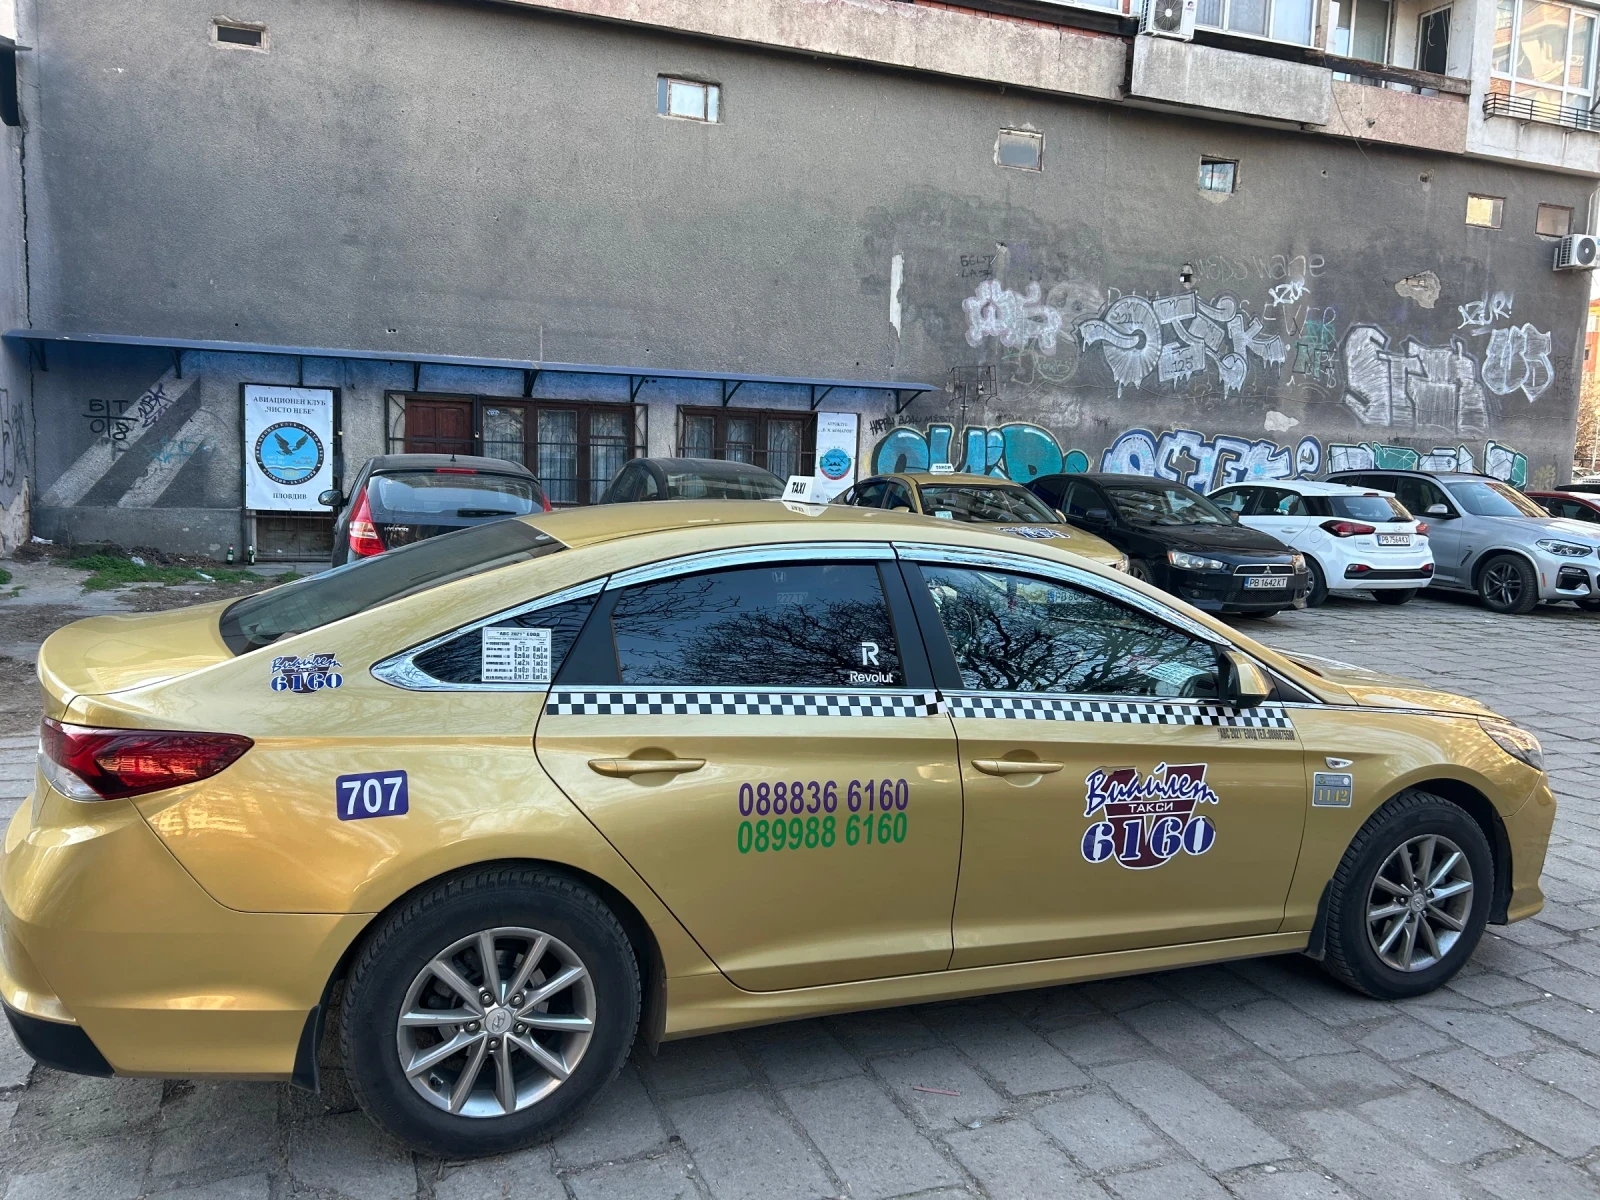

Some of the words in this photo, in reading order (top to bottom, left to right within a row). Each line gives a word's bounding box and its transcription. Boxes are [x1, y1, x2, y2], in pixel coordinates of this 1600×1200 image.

[253, 396, 306, 406] АВИАЦИОНЕН
[306, 398, 326, 406] КЛУБ
[272, 492, 307, 500] ПЛОВДИВ
[791, 481, 807, 494] TAXI
[861, 642, 880, 665] R
[270, 672, 344, 692] 6160
[850, 671, 894, 683] Revolut
[341, 776, 403, 815] 707
[738, 780, 838, 817] 088836
[847, 778, 909, 813] 6160
[1128, 802, 1174, 813] ТАКСИ
[737, 815, 836, 854] 089988
[845, 812, 908, 847] 6160
[1081, 815, 1217, 864] 6160
